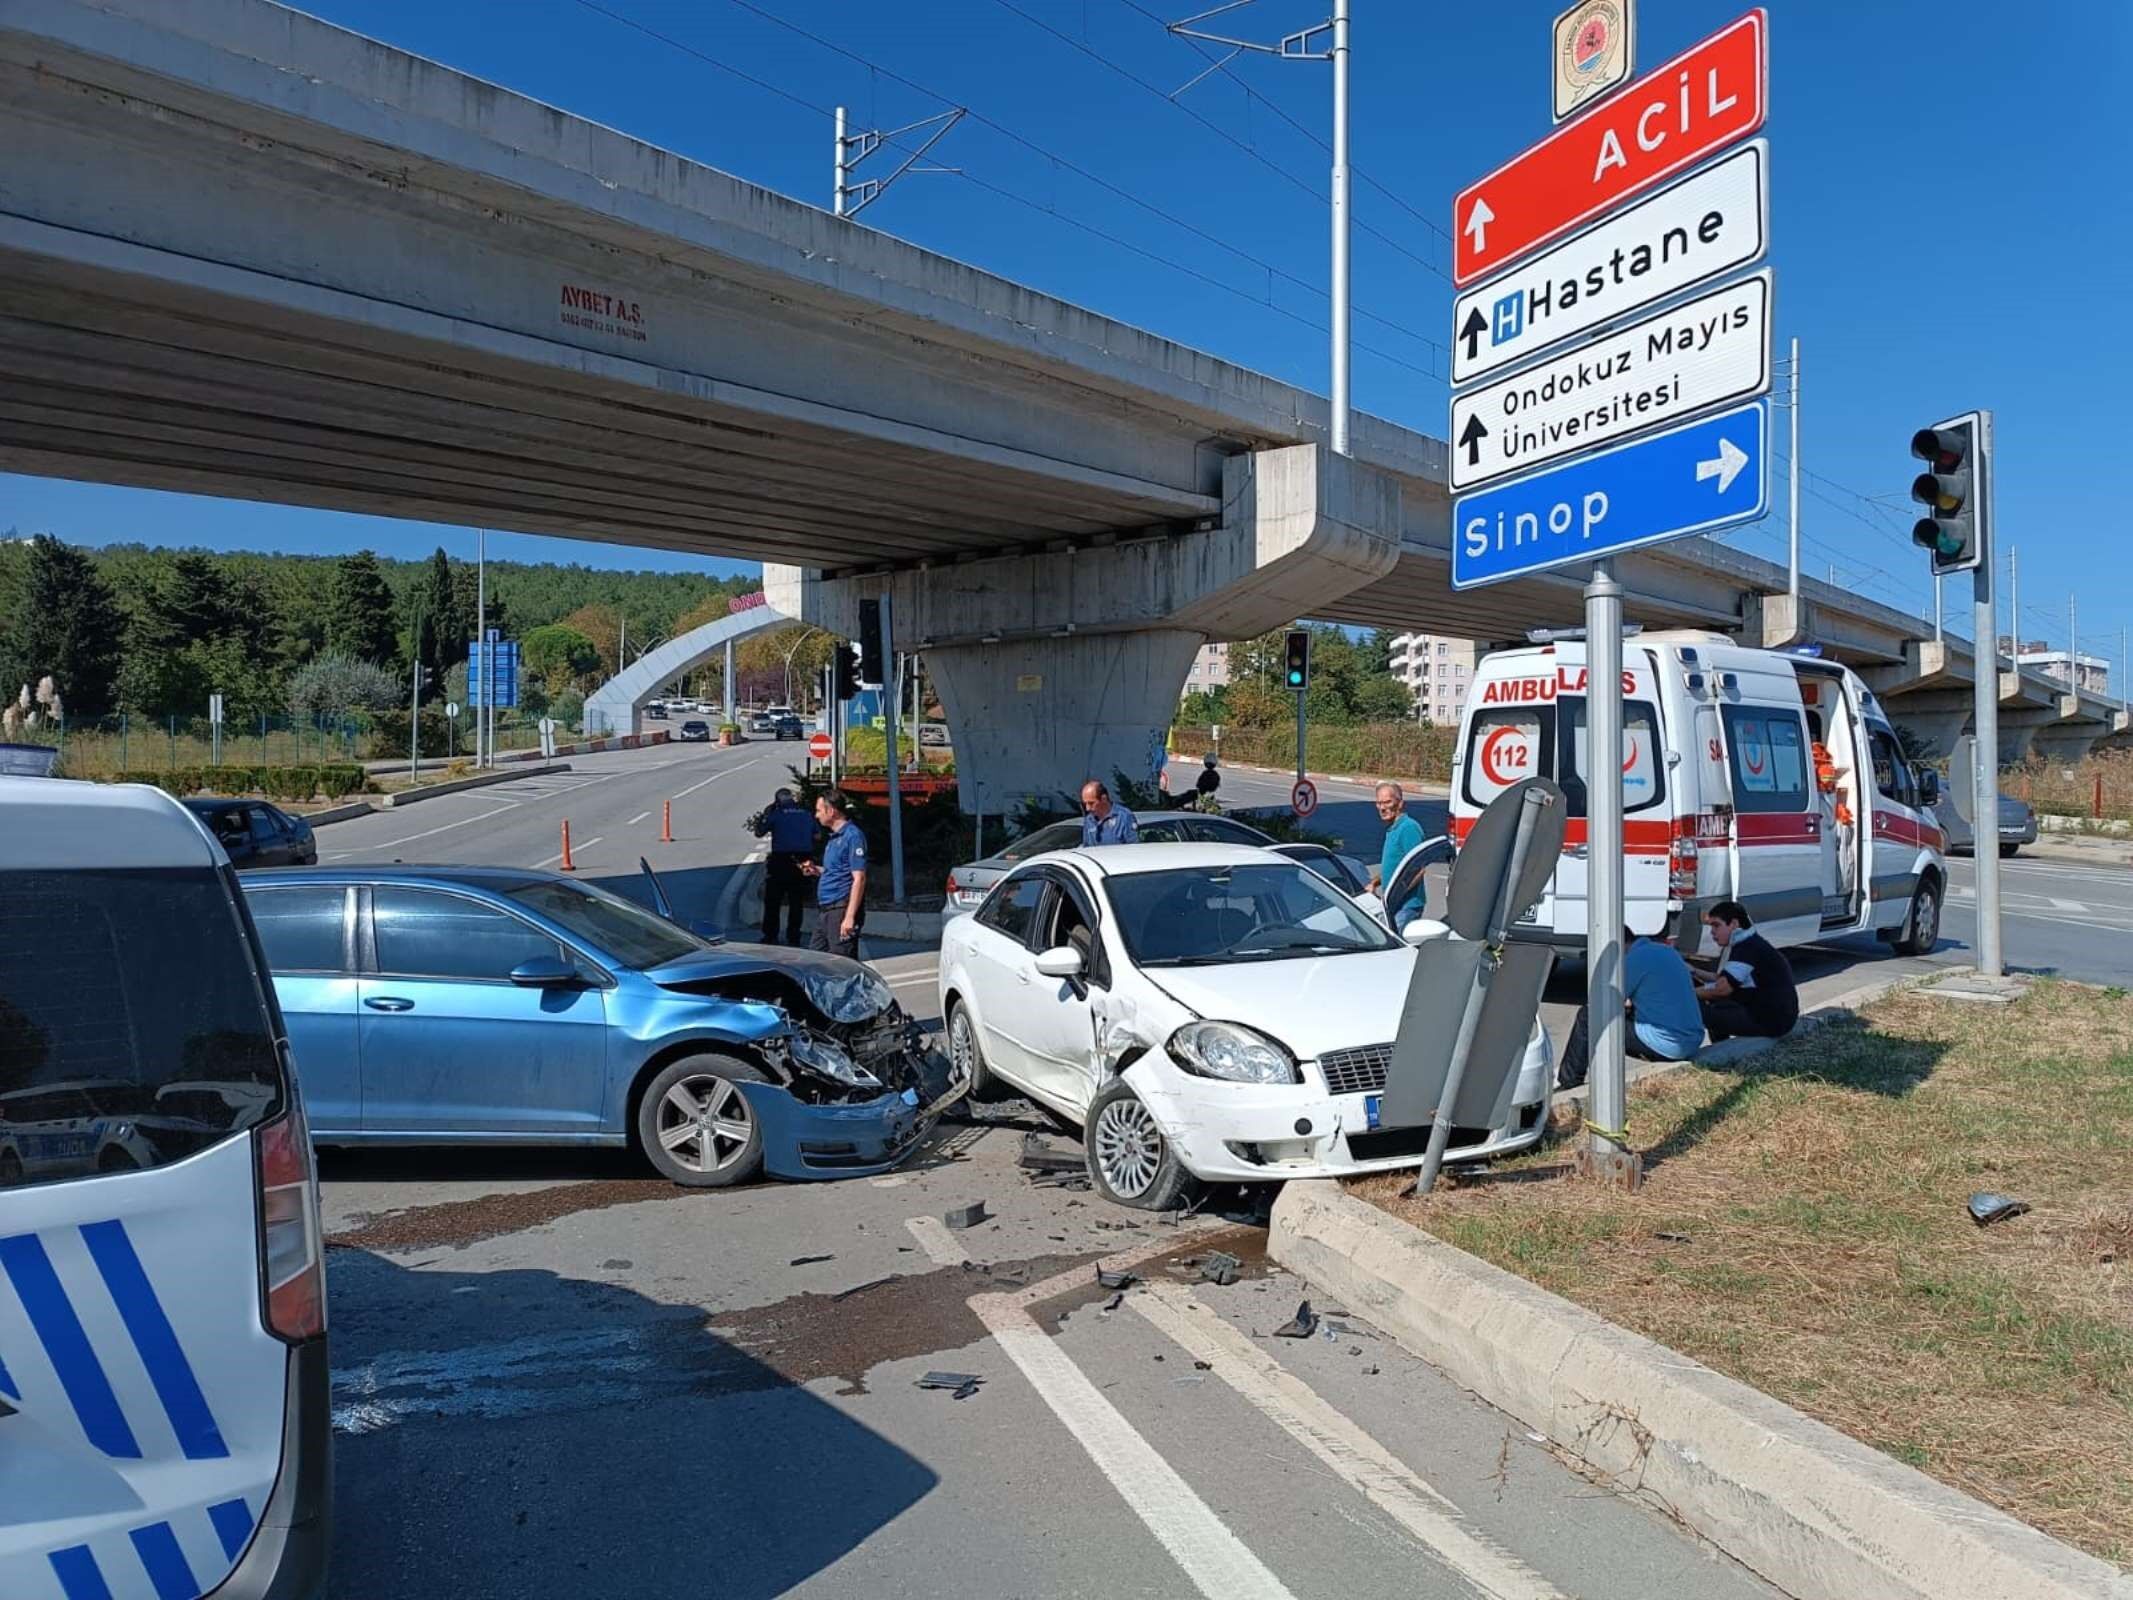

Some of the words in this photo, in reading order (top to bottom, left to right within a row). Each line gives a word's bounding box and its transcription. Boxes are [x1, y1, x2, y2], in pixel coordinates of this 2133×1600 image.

[1593, 67, 1737, 184] ACİL
[1528, 210, 1724, 324] Hastane
[1503, 350, 1632, 416] Ondokuz
[1647, 305, 1749, 361] Mayıs
[1503, 374, 1680, 458] Üniversitesi
[1465, 491, 1609, 558] Sinop
[1483, 667, 1636, 703] AMBULAS
[1493, 745, 1527, 767] 112
